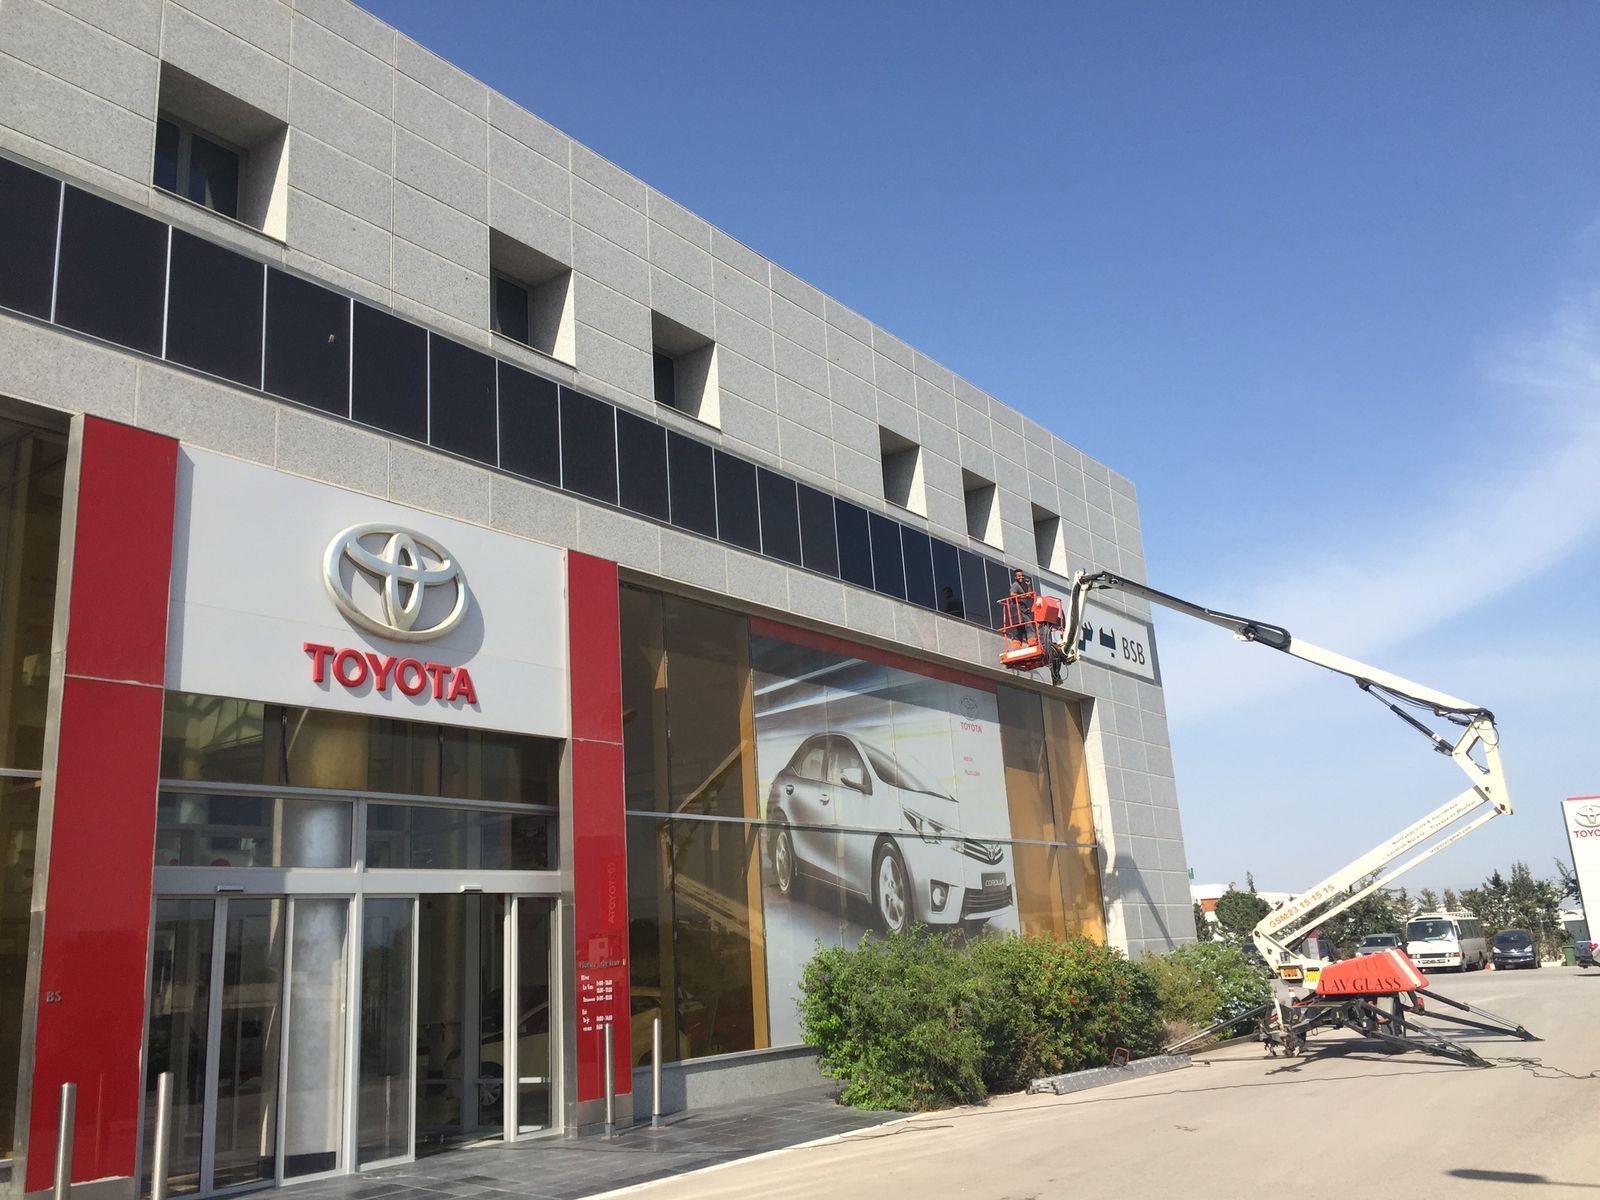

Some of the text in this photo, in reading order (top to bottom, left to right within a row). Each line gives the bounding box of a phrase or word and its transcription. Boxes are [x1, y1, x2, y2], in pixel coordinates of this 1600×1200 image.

[1121, 637, 1146, 666] BSB
[303, 641, 477, 705] TOYOTA
[960, 721, 983, 734] TOYOTA
[1300, 898, 1311, 909] 15
[1311, 890, 1323, 901] 15
[1323, 883, 1335, 894] 15
[1352, 976, 1402, 991] GLASS
[46, 991, 62, 1003] BS
